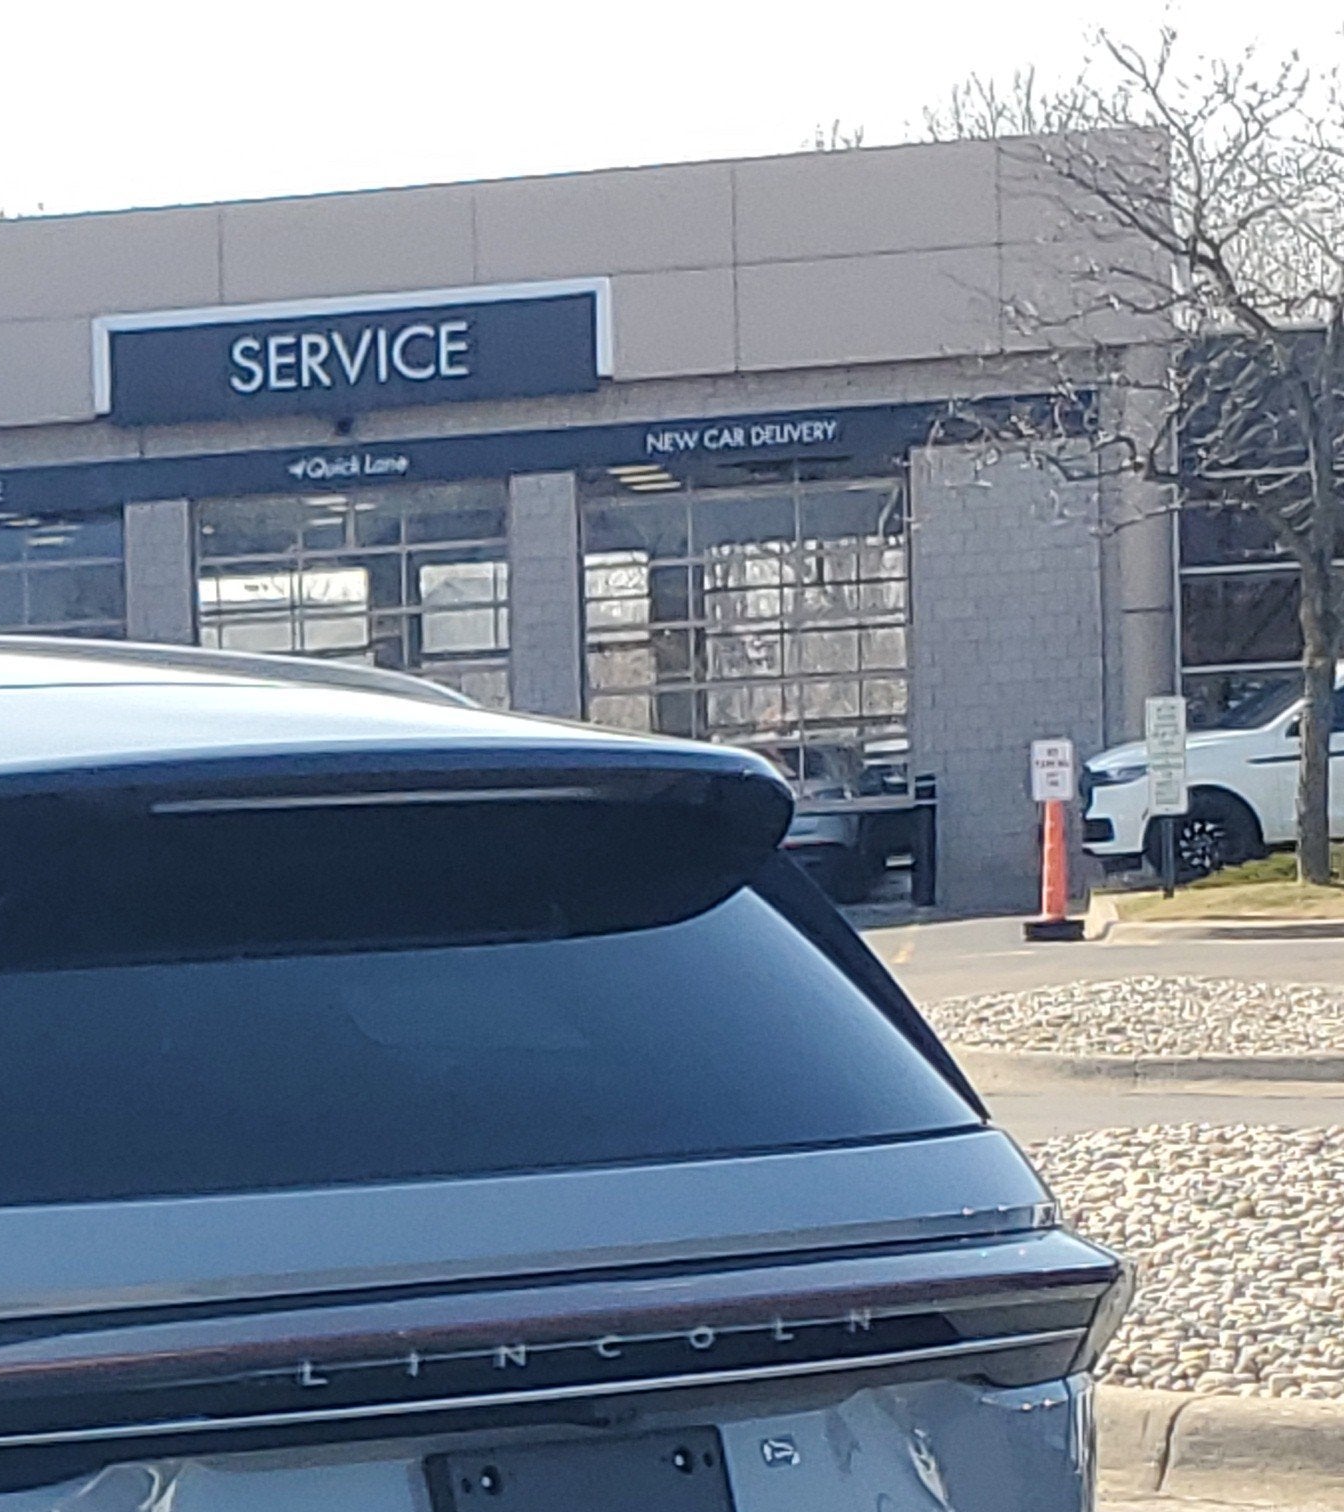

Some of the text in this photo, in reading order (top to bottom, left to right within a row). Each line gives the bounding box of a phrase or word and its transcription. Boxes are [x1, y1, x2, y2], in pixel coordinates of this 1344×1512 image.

[230, 321, 469, 393] SERVICE
[645, 420, 837, 453] NEW CAR DELIVERY
[298, 1308, 872, 1387] LINCOLN
